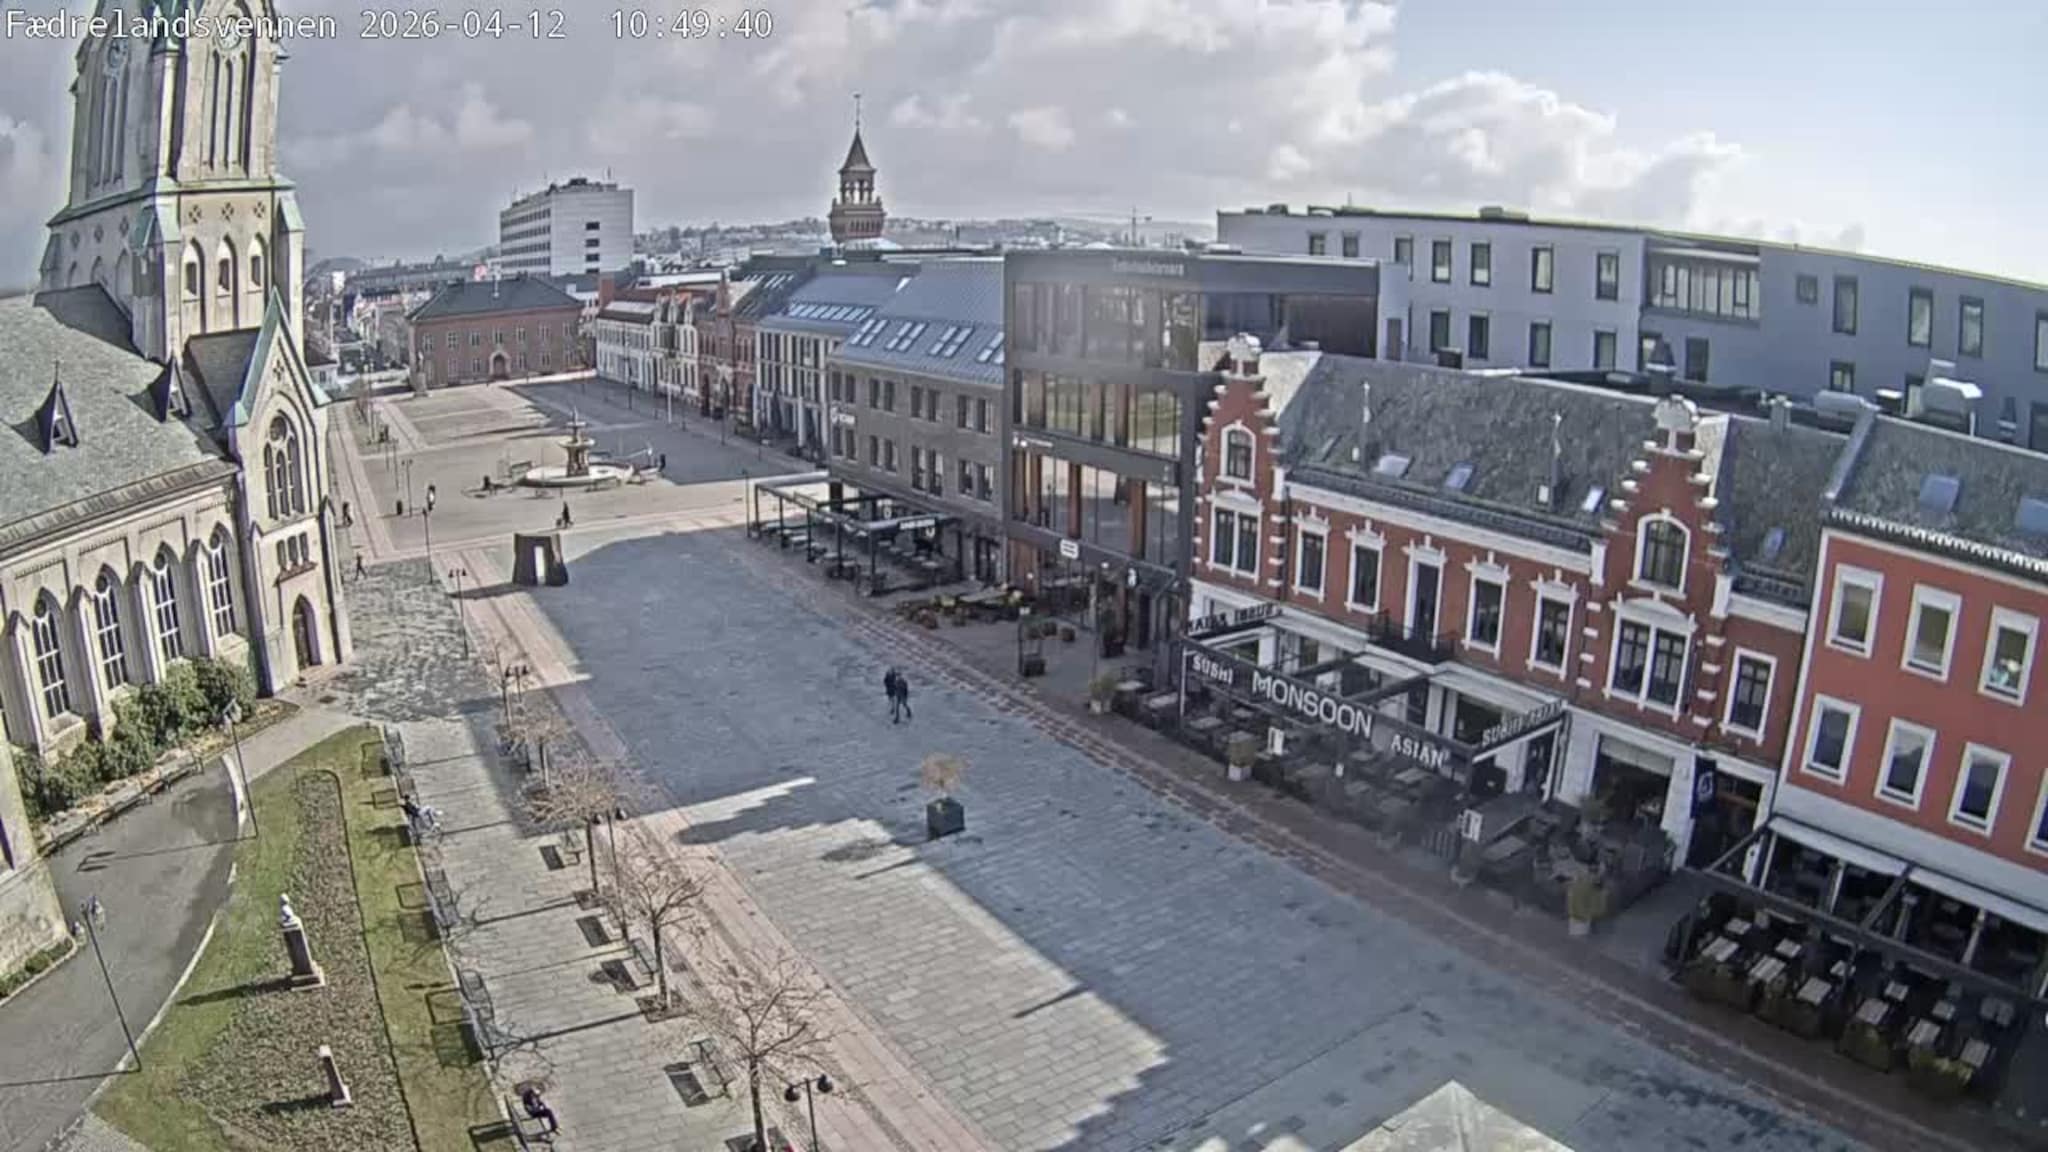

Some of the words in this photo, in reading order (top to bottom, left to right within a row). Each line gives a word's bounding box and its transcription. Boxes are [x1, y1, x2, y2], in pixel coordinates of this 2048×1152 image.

[1192, 653, 1233, 685] SUSHI
[1252, 670, 1373, 739] MONSOON
[1391, 733, 1445, 767] ASIAN
